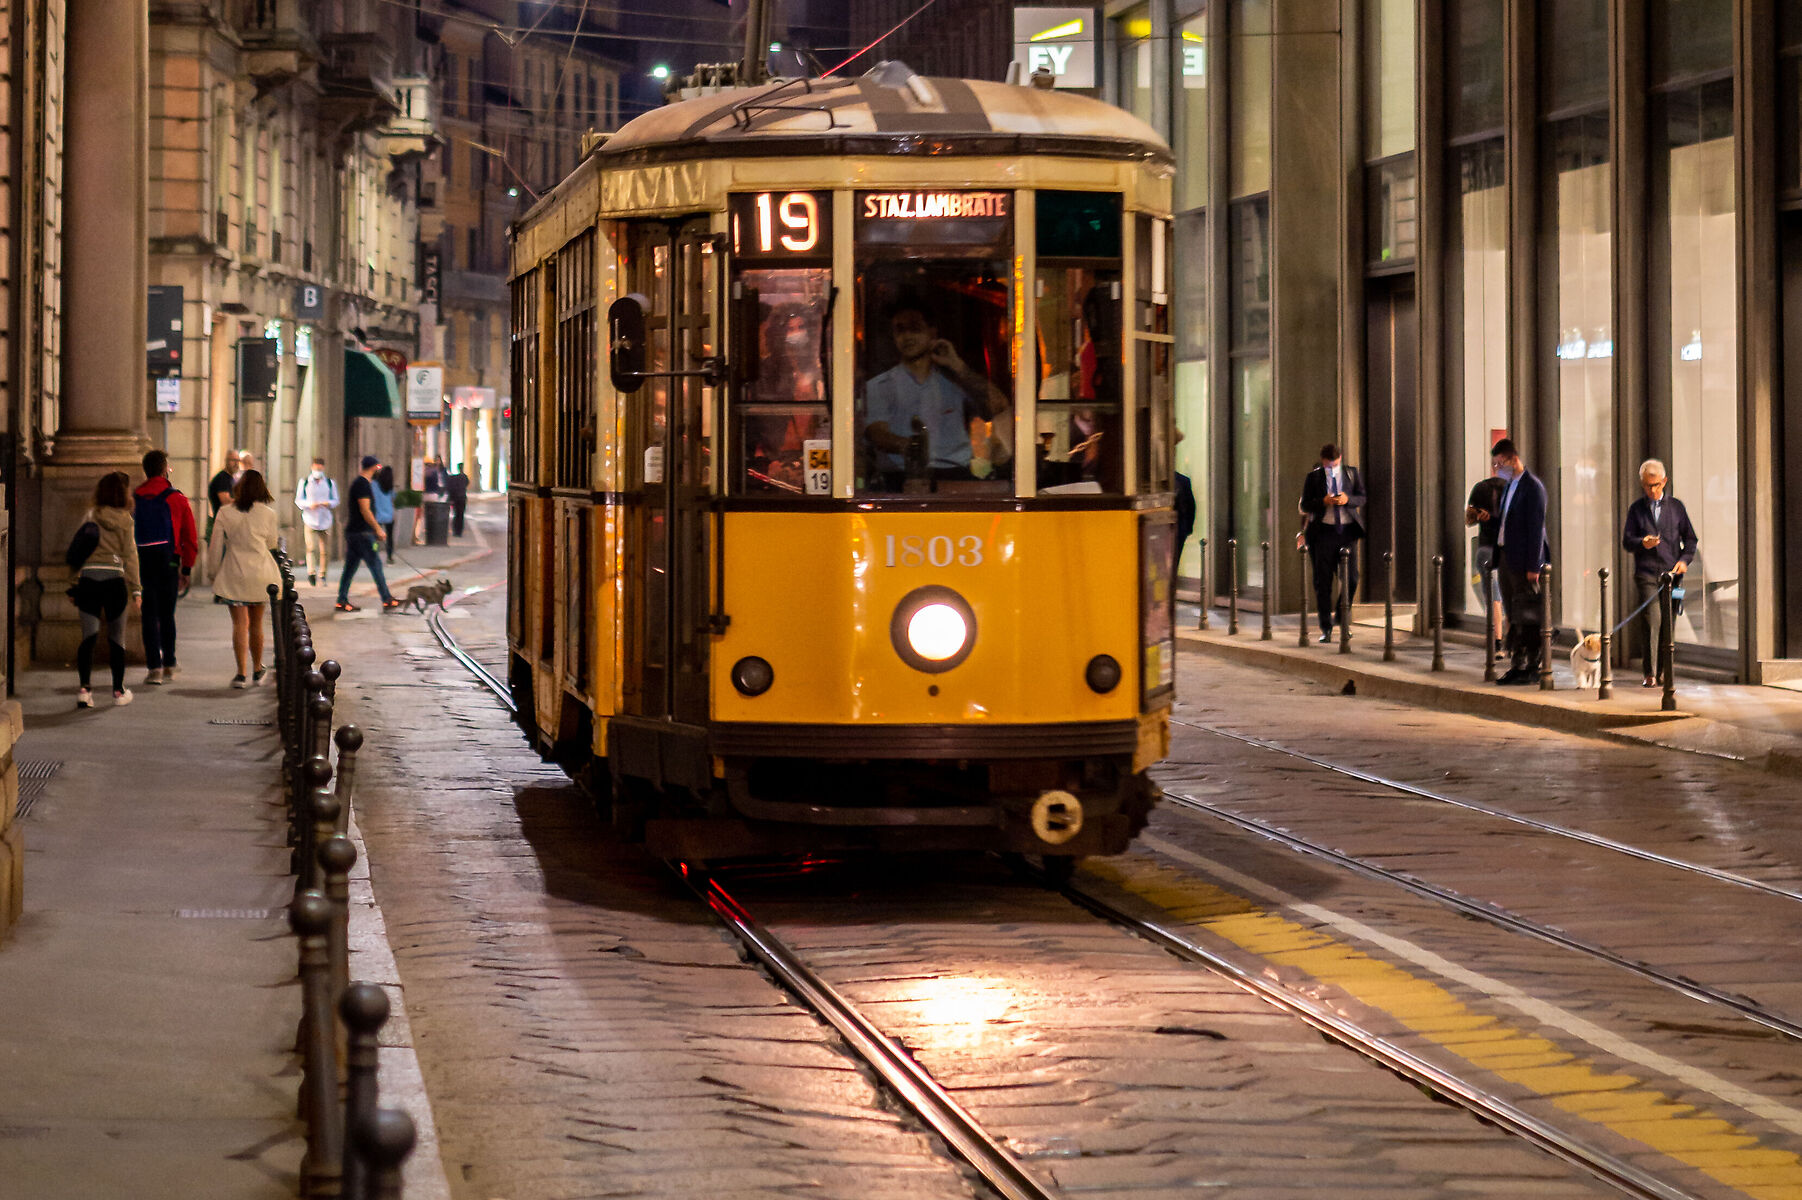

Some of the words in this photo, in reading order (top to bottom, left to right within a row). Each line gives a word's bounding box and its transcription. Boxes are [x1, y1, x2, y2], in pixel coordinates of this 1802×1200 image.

[1028, 44, 1074, 76] EY
[757, 192, 820, 252] 19
[303, 286, 318, 308] B
[811, 472, 829, 490] 19
[885, 534, 984, 568] 1803
